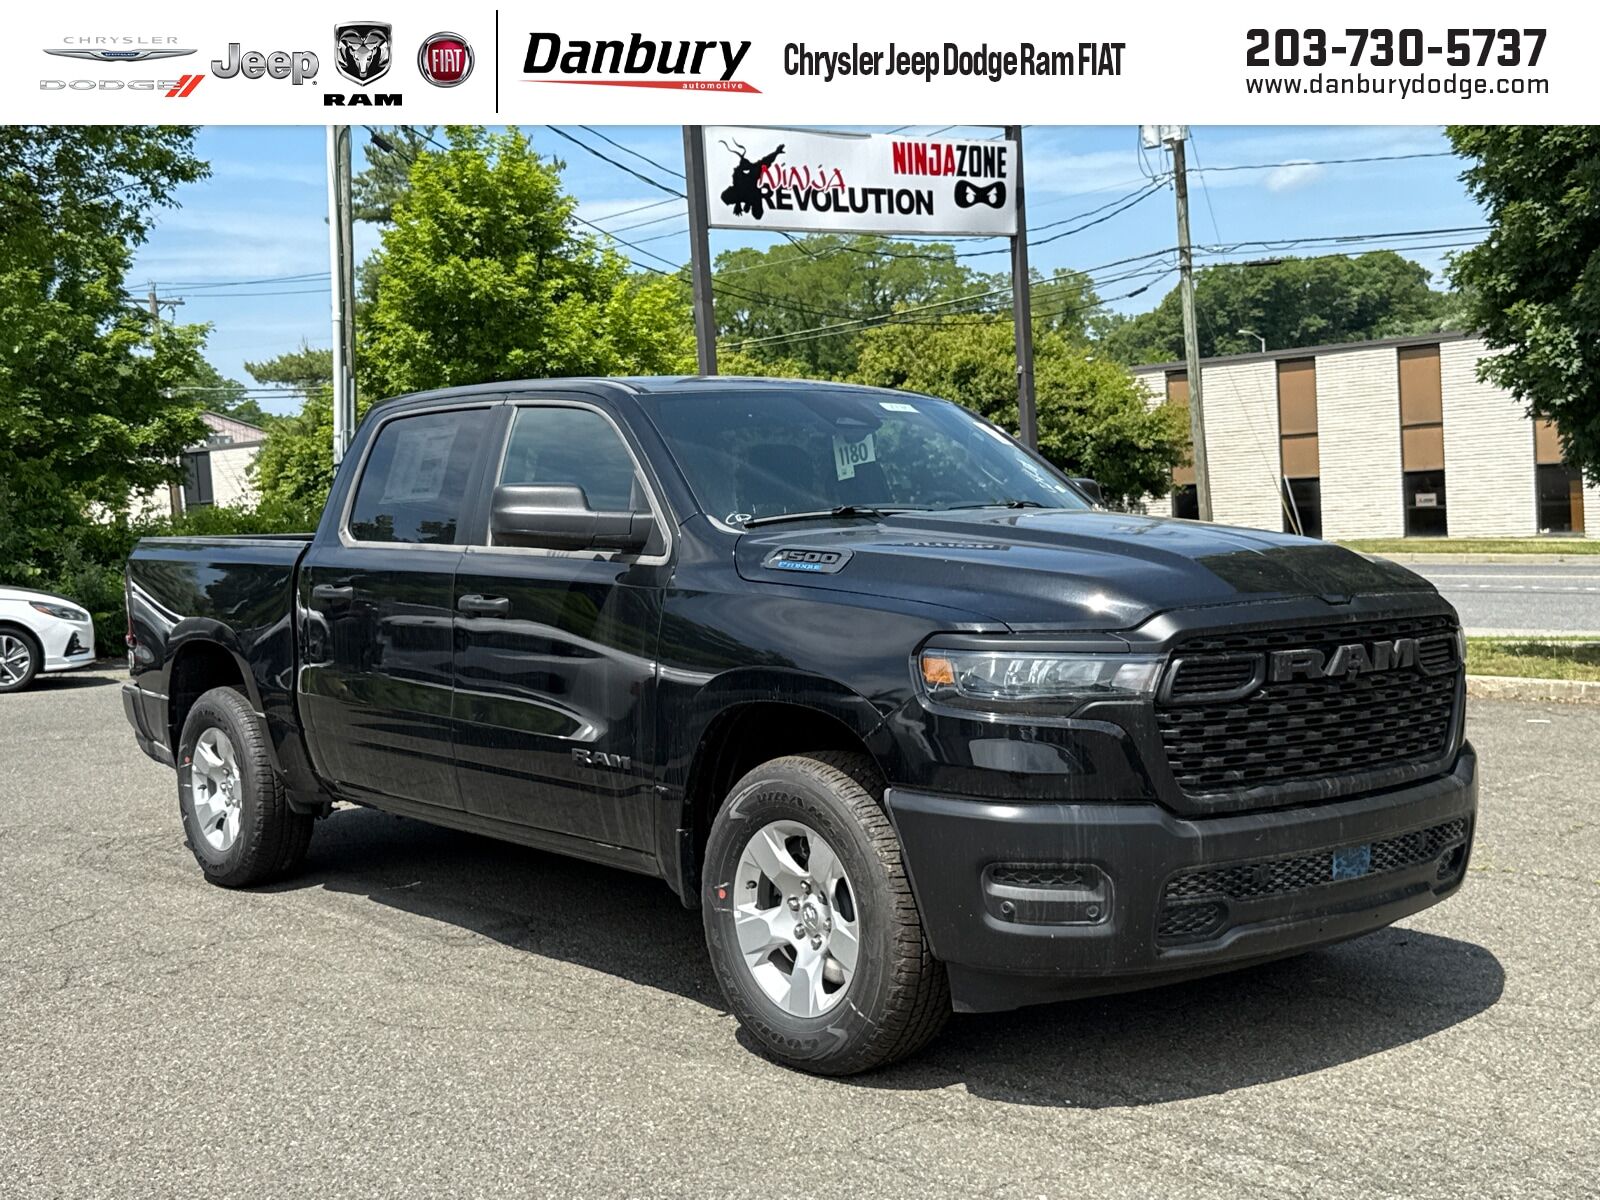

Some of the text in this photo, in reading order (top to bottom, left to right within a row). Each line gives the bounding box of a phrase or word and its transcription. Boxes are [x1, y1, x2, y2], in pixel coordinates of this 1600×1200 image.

[758, 183, 935, 216] REVOLUTION
[773, 550, 839, 564] 1500
[1268, 637, 1415, 682] RAM
[571, 747, 631, 770] RAM
